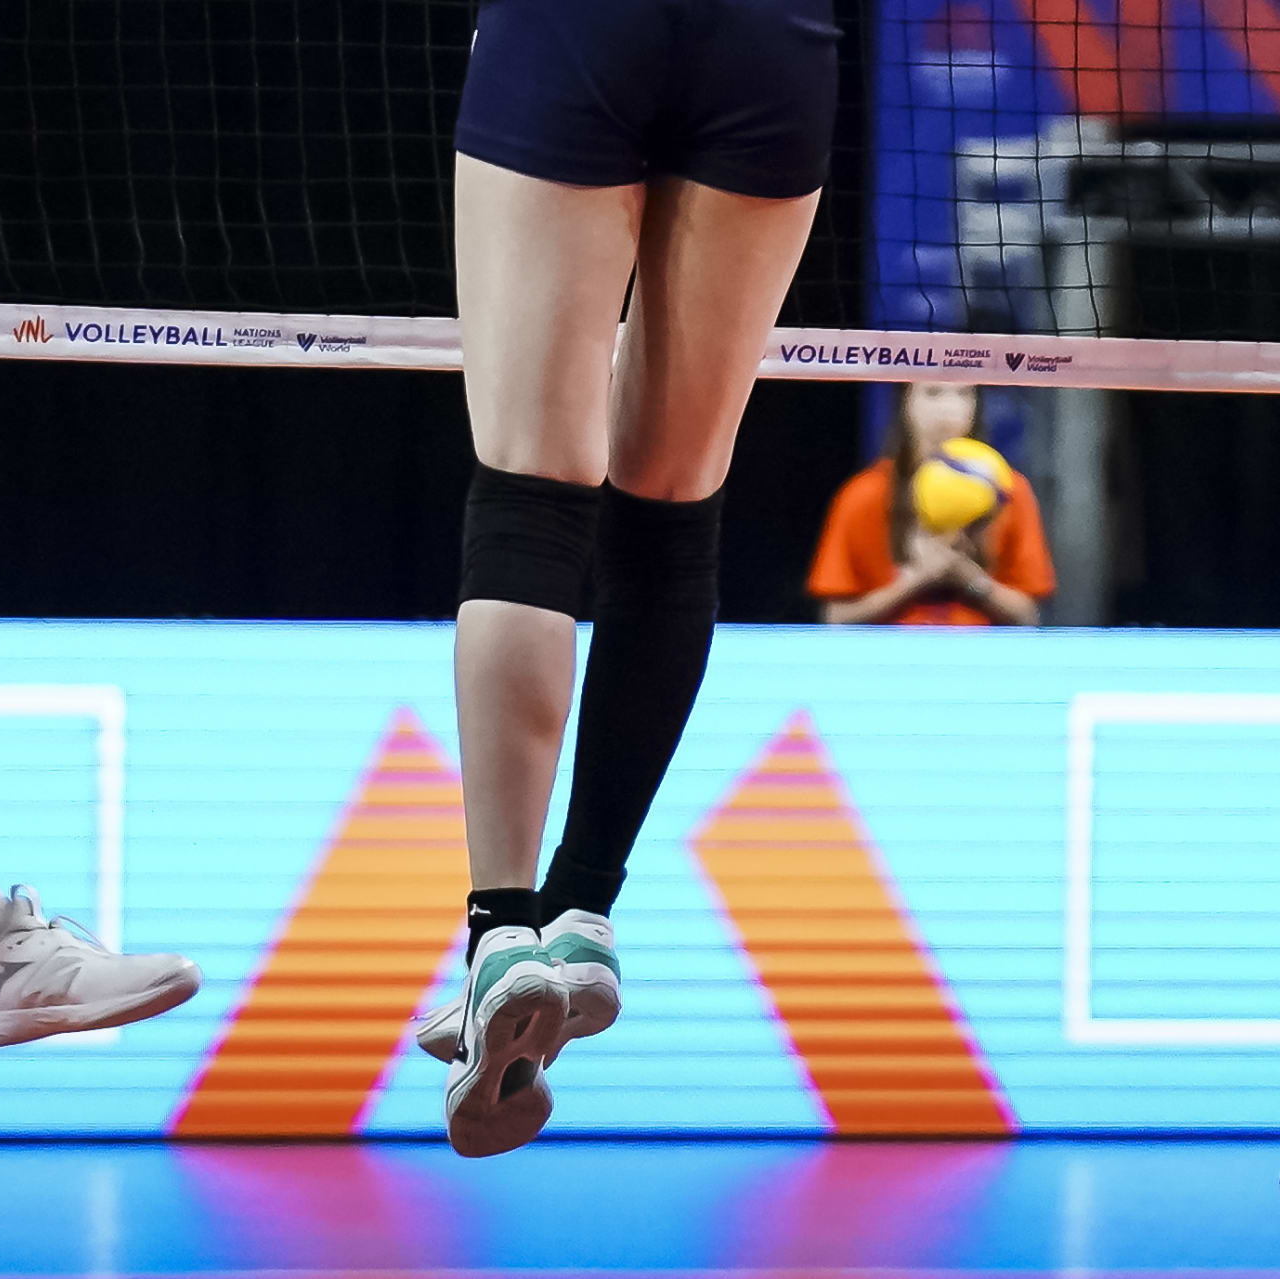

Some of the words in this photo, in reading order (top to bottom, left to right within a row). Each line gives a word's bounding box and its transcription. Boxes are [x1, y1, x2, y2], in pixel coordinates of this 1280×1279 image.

[13, 314, 54, 344] VNL
[65, 322, 228, 347] VOLLEYBALL
[233, 328, 281, 338] NATIONS
[780, 344, 938, 367] VOLLEYBALL
